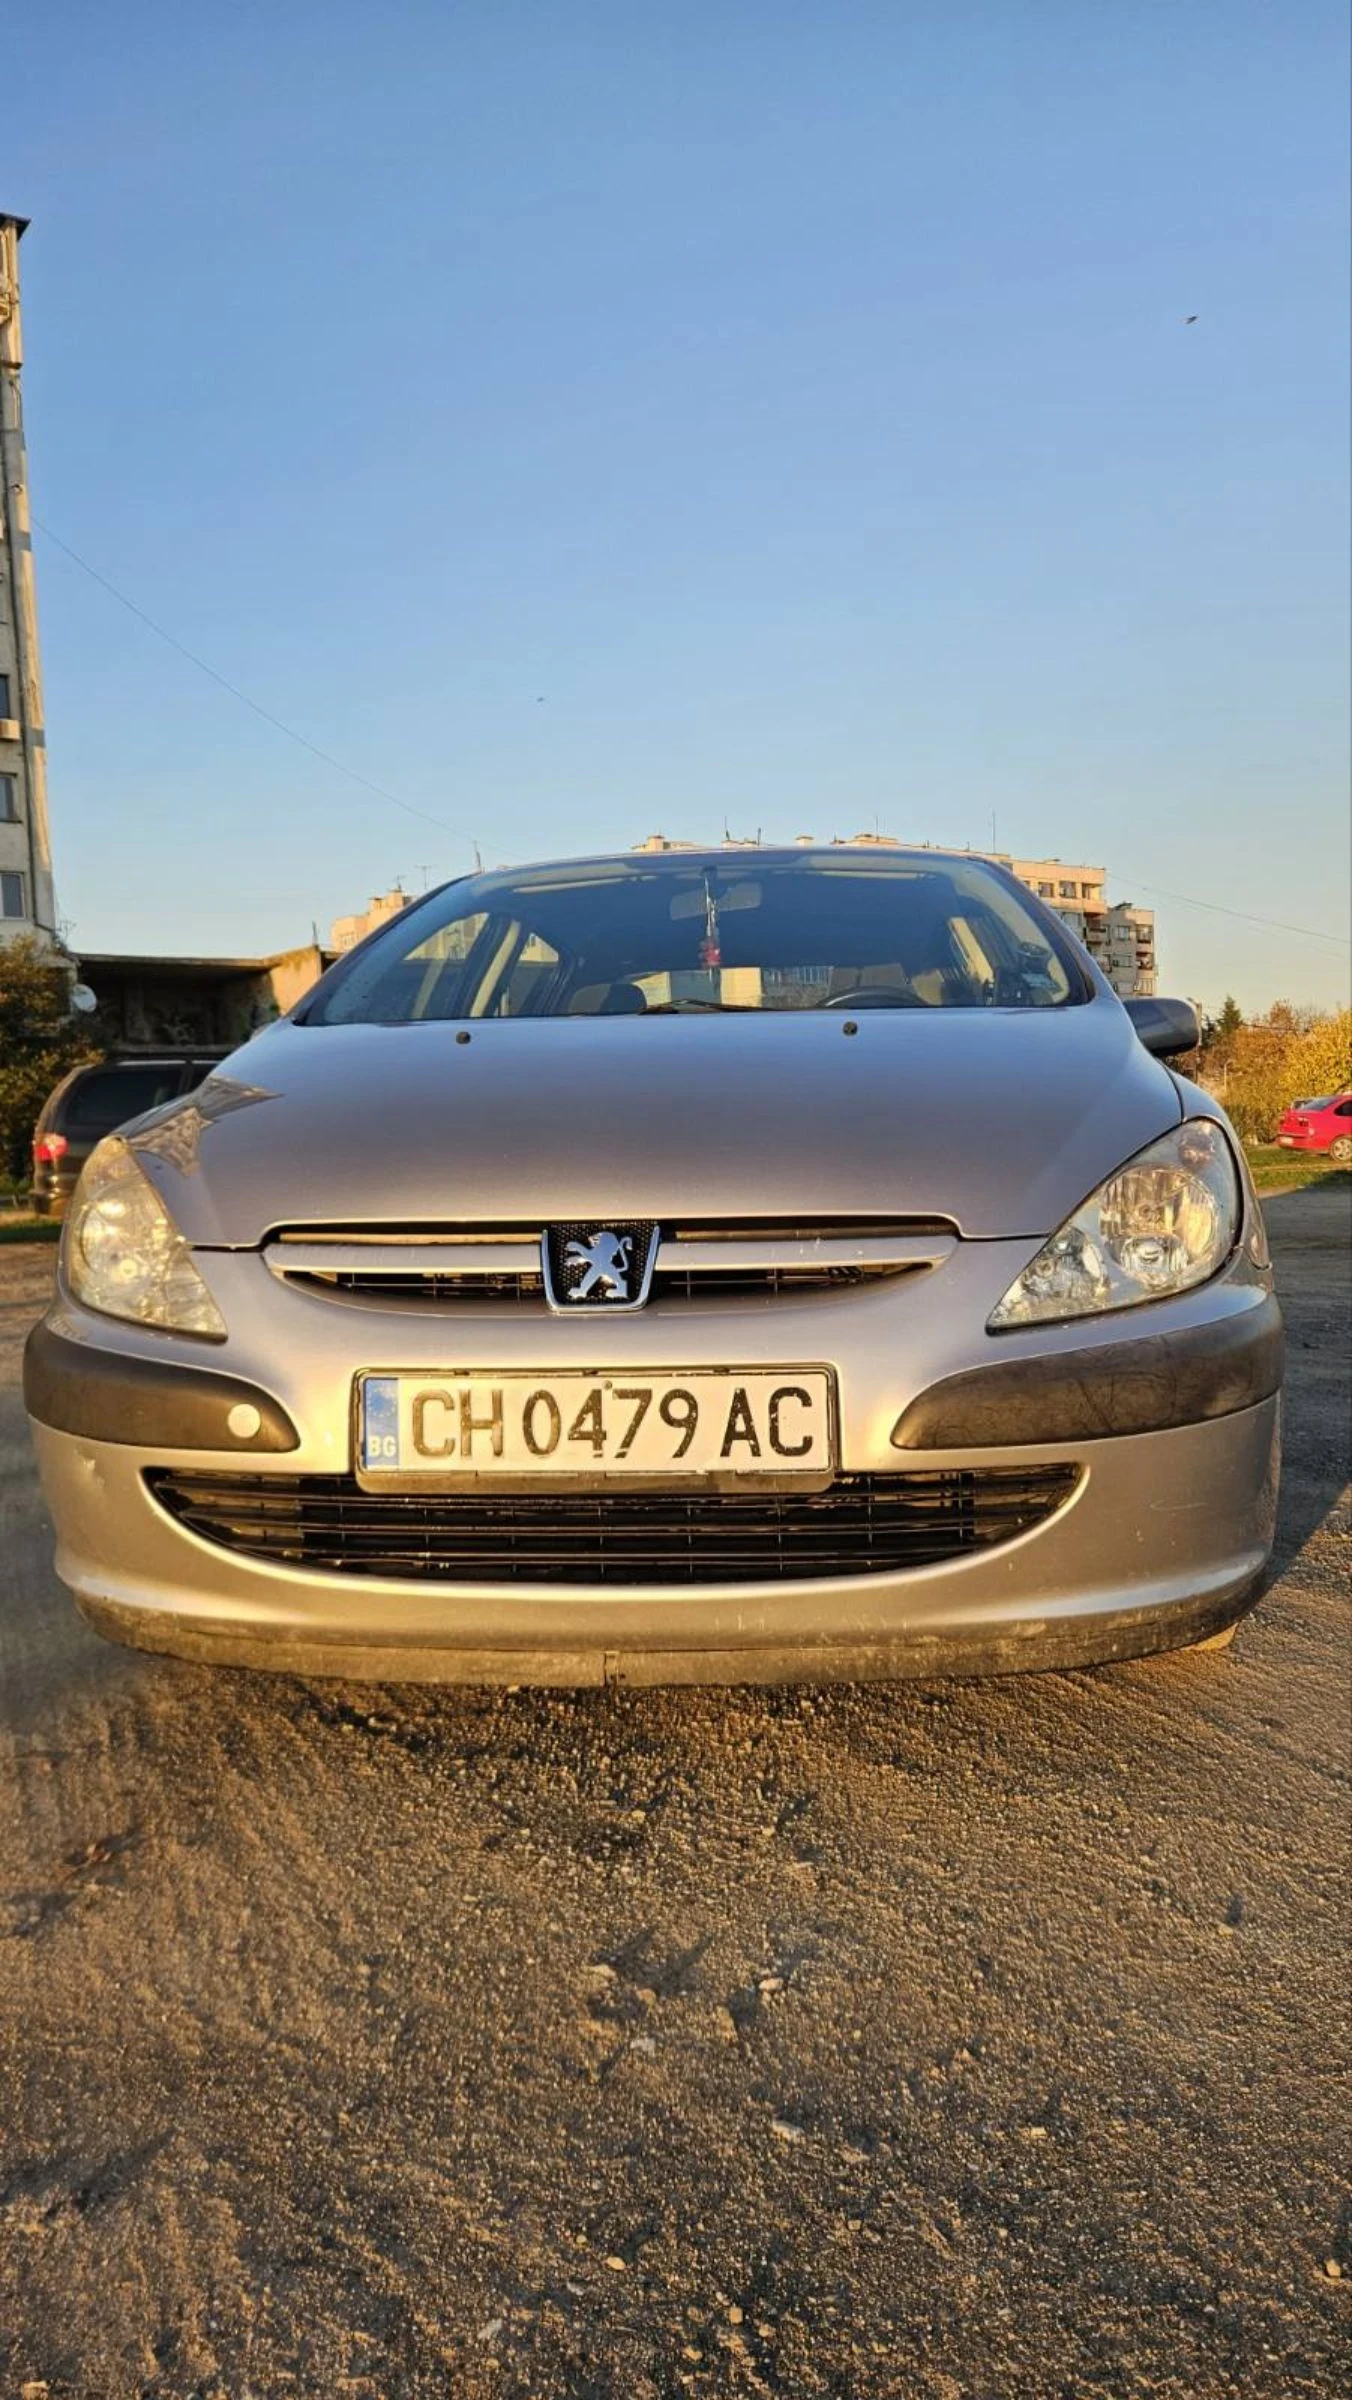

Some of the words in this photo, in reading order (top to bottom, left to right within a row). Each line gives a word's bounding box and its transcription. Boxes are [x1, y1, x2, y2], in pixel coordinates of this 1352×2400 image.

[367, 1434, 397, 1458] BG
[412, 1388, 504, 1458] CH
[522, 1388, 699, 1459] 0479
[719, 1386, 813, 1458] AC
